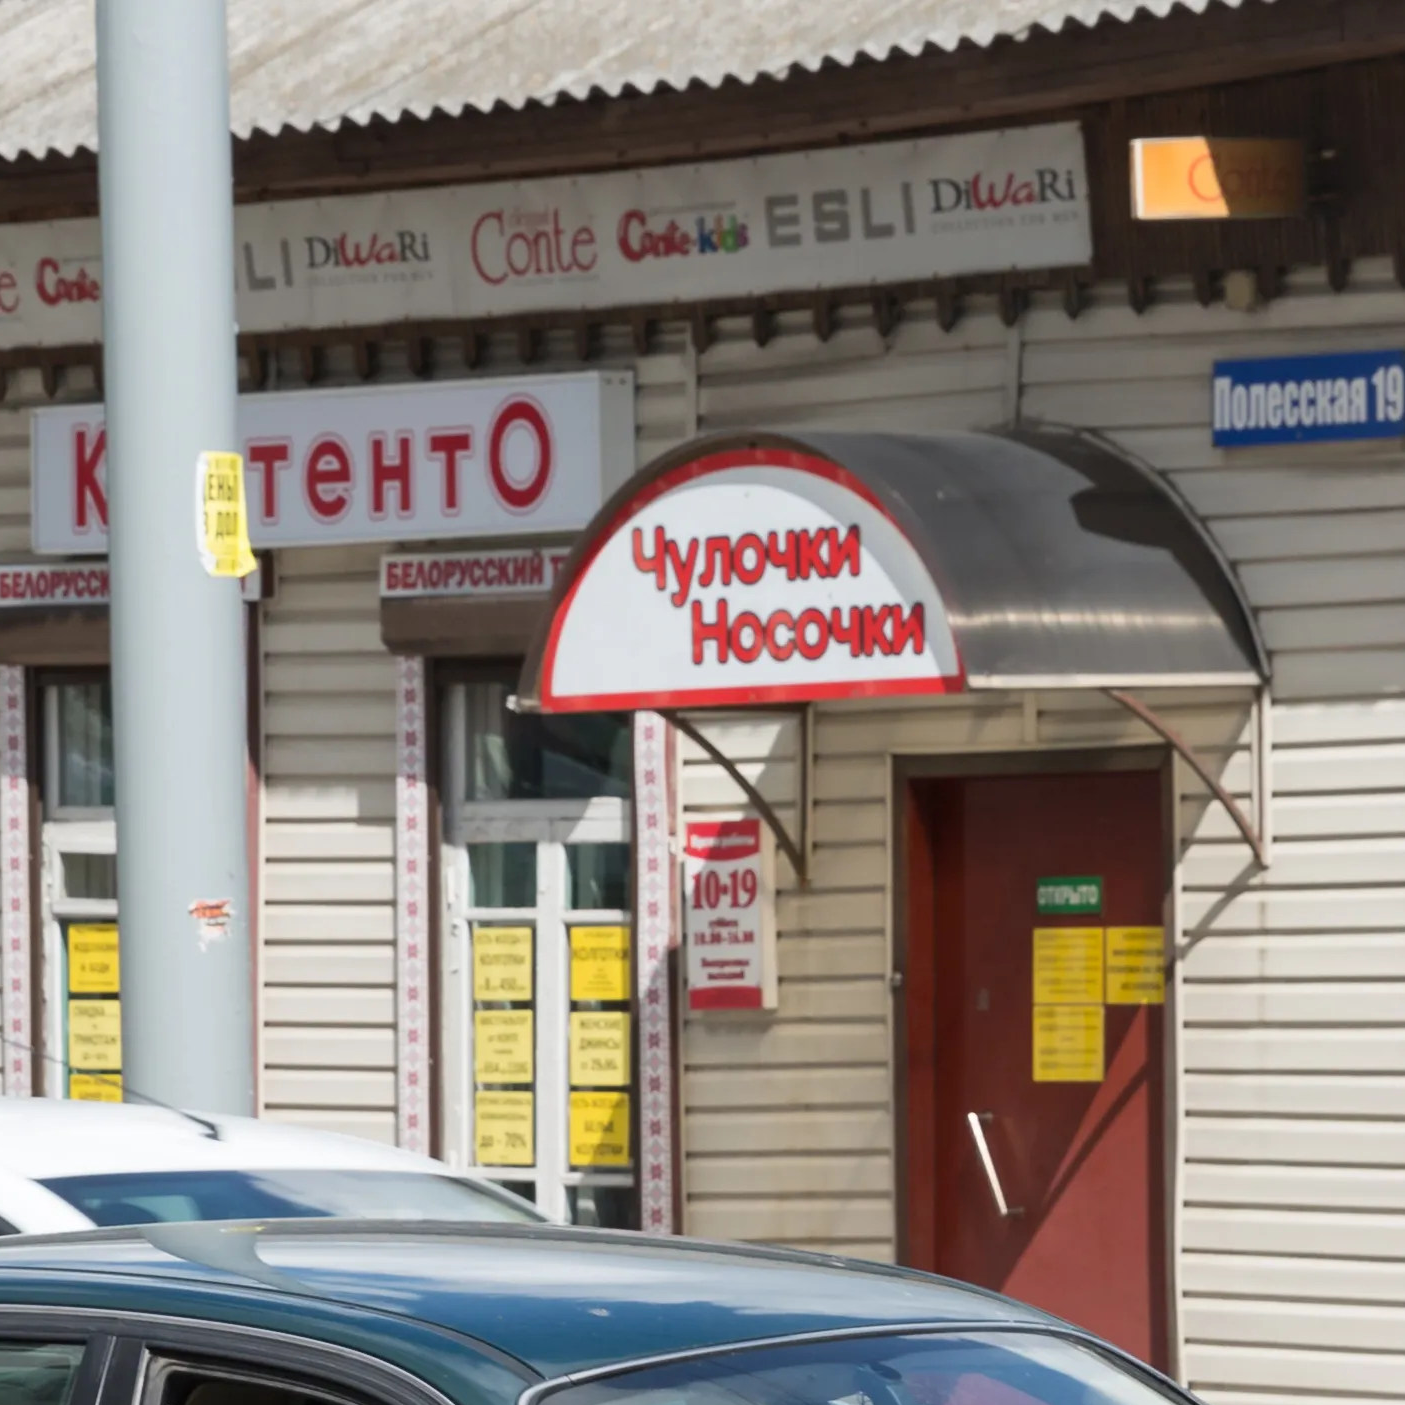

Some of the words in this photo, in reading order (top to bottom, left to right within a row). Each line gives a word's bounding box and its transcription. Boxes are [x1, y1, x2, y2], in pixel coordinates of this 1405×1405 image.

[304, 229, 431, 269] DiWaRi
[471, 207, 597, 285] Conte
[764, 181, 916, 247] ESLI
[928, 168, 1076, 213] DiWaRi
[1213, 376, 1367, 430] Полесская
[1371, 364, 1405, 422] 19
[386, 549, 542, 591] БЕЛОРУССКИЙ
[632, 525, 860, 607] Чулочки
[691, 598, 924, 664] Носочки
[1037, 885, 1098, 905] ОТКРЫТО
